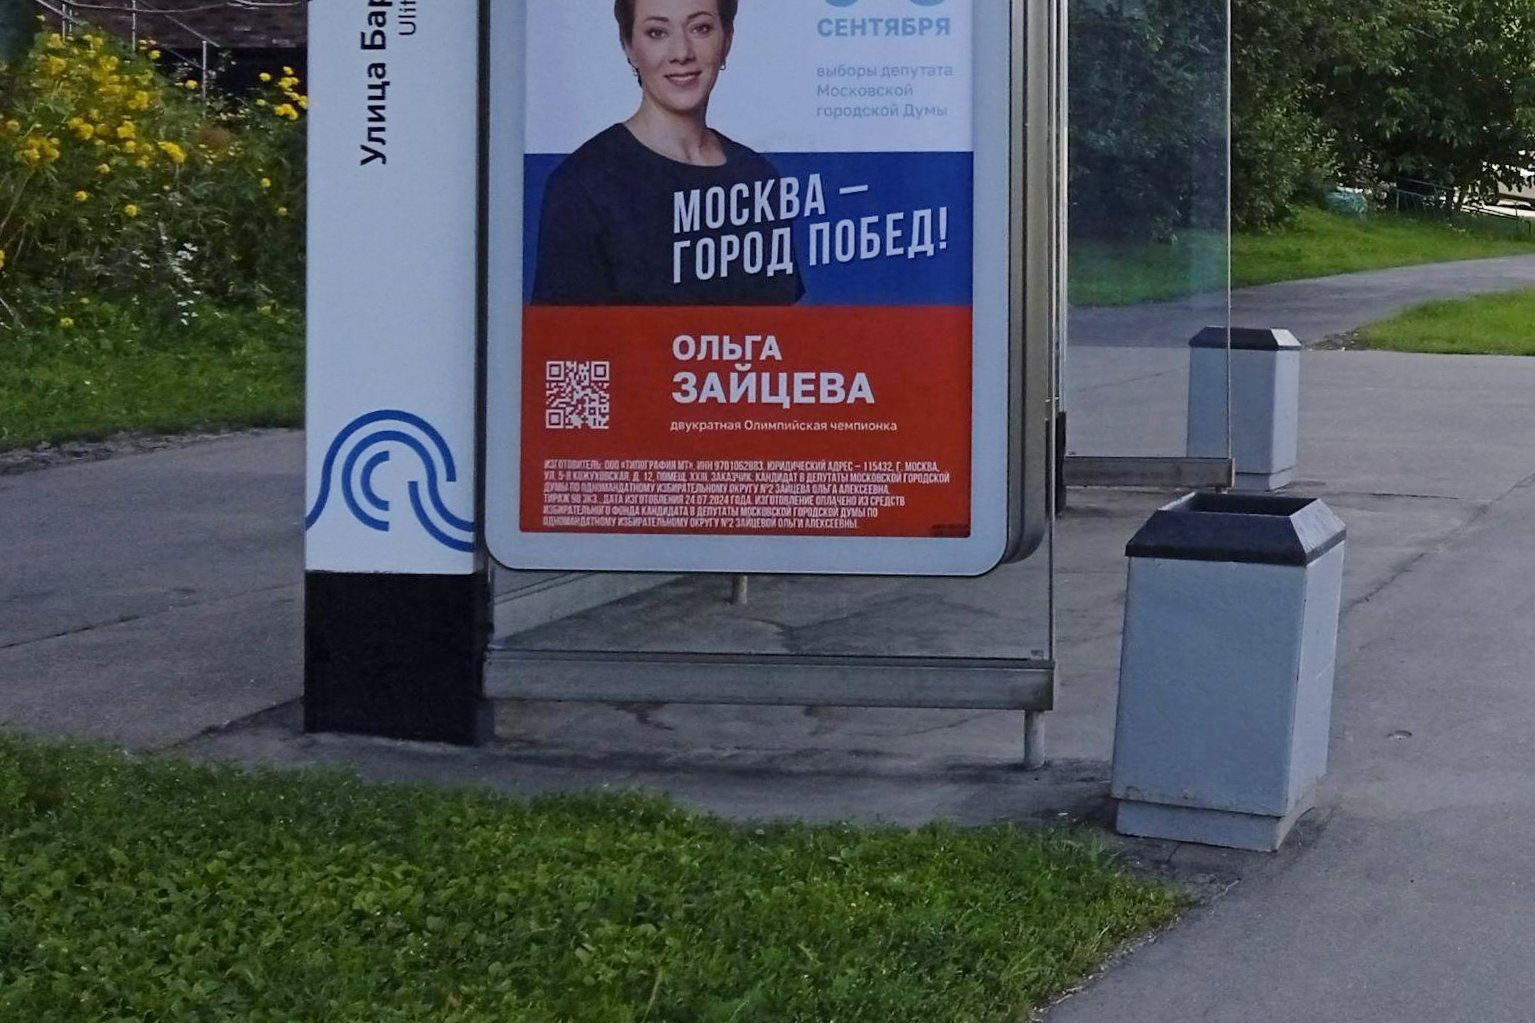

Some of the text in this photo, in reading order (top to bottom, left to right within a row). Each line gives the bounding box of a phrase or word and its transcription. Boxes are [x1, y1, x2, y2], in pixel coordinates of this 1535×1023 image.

[817, 17, 950, 37] СЕНТЯБРЯ
[817, 64, 953, 78] выборы депутата
[817, 83, 913, 97] Московской
[360, 62, 390, 166] Улица
[817, 103, 948, 119] городской Думы
[673, 173, 826, 234] МОСКВА
[673, 206, 948, 284] ГОРОД ПОБЕД!
[672, 335, 783, 361] ОЛЬГА
[672, 363, 875, 409] ЗАЙЦЕВА
[670, 419, 897, 432] двукратная Олимпийская чемпионка
[604, 460, 620, 470] ООО
[696, 461, 713, 470] ИНН
[767, 461, 826, 471] ЮРИДИЧЕСКИЙ
[828, 461, 853, 471] АДРЕС
[756, 472, 797, 482] КАНДИДАТ
[806, 472, 848, 482] ДЕПУТАТЫ
[851, 473, 902, 483] МОСКОВСКОЙ
[903, 473, 950, 483] ГОРОДСКОЙ
[581, 483, 655, 493] ОДНОМАНДАТНОМУ
[657, 483, 728, 493] ИЗБИРАТЕЛЬНОМУ
[730, 484, 758, 494] ОКРУГУ
[776, 484, 810, 494] ЗАЙЦЕВА
[812, 484, 837, 494] ОЛЬГА
[544, 494, 570, 504] ТИРАЖ
[603, 494, 623, 504] ДАТА
[625, 494, 683, 504] ИЗГОТОВЛЕНИЯ
[686, 495, 728, 505] 24.07.2024
[755, 496, 814, 506] ИЗГОТОВЛЕНИЕ
[816, 496, 856, 506] ОПЛАЧЕНО
[870, 496, 905, 506] СРЕДСТВ
[543, 505, 610, 515] ИЗБИРАТЕЛЬНОГО
[612, 506, 639, 515] ФОНДА
[642, 506, 688, 516] КАНДИДАТА
[697, 506, 739, 516] ДЕПУТАТЫ
[740, 507, 791, 516] МОСКОВСКОЙ
[793, 507, 838, 517] ГОРОДСКОЙ
[840, 508, 865, 517] ДУМЫ
[543, 516, 616, 526] ОДНОМАНДАТНОМУ
[618, 517, 688, 527] ИЗБИРАТЕЛЬНОМУ
[690, 517, 719, 527] ОКРУГУ
[736, 518, 776, 527] ЗАЙЦЕВОЙ
[778, 518, 803, 528] ОЛЬГИ
